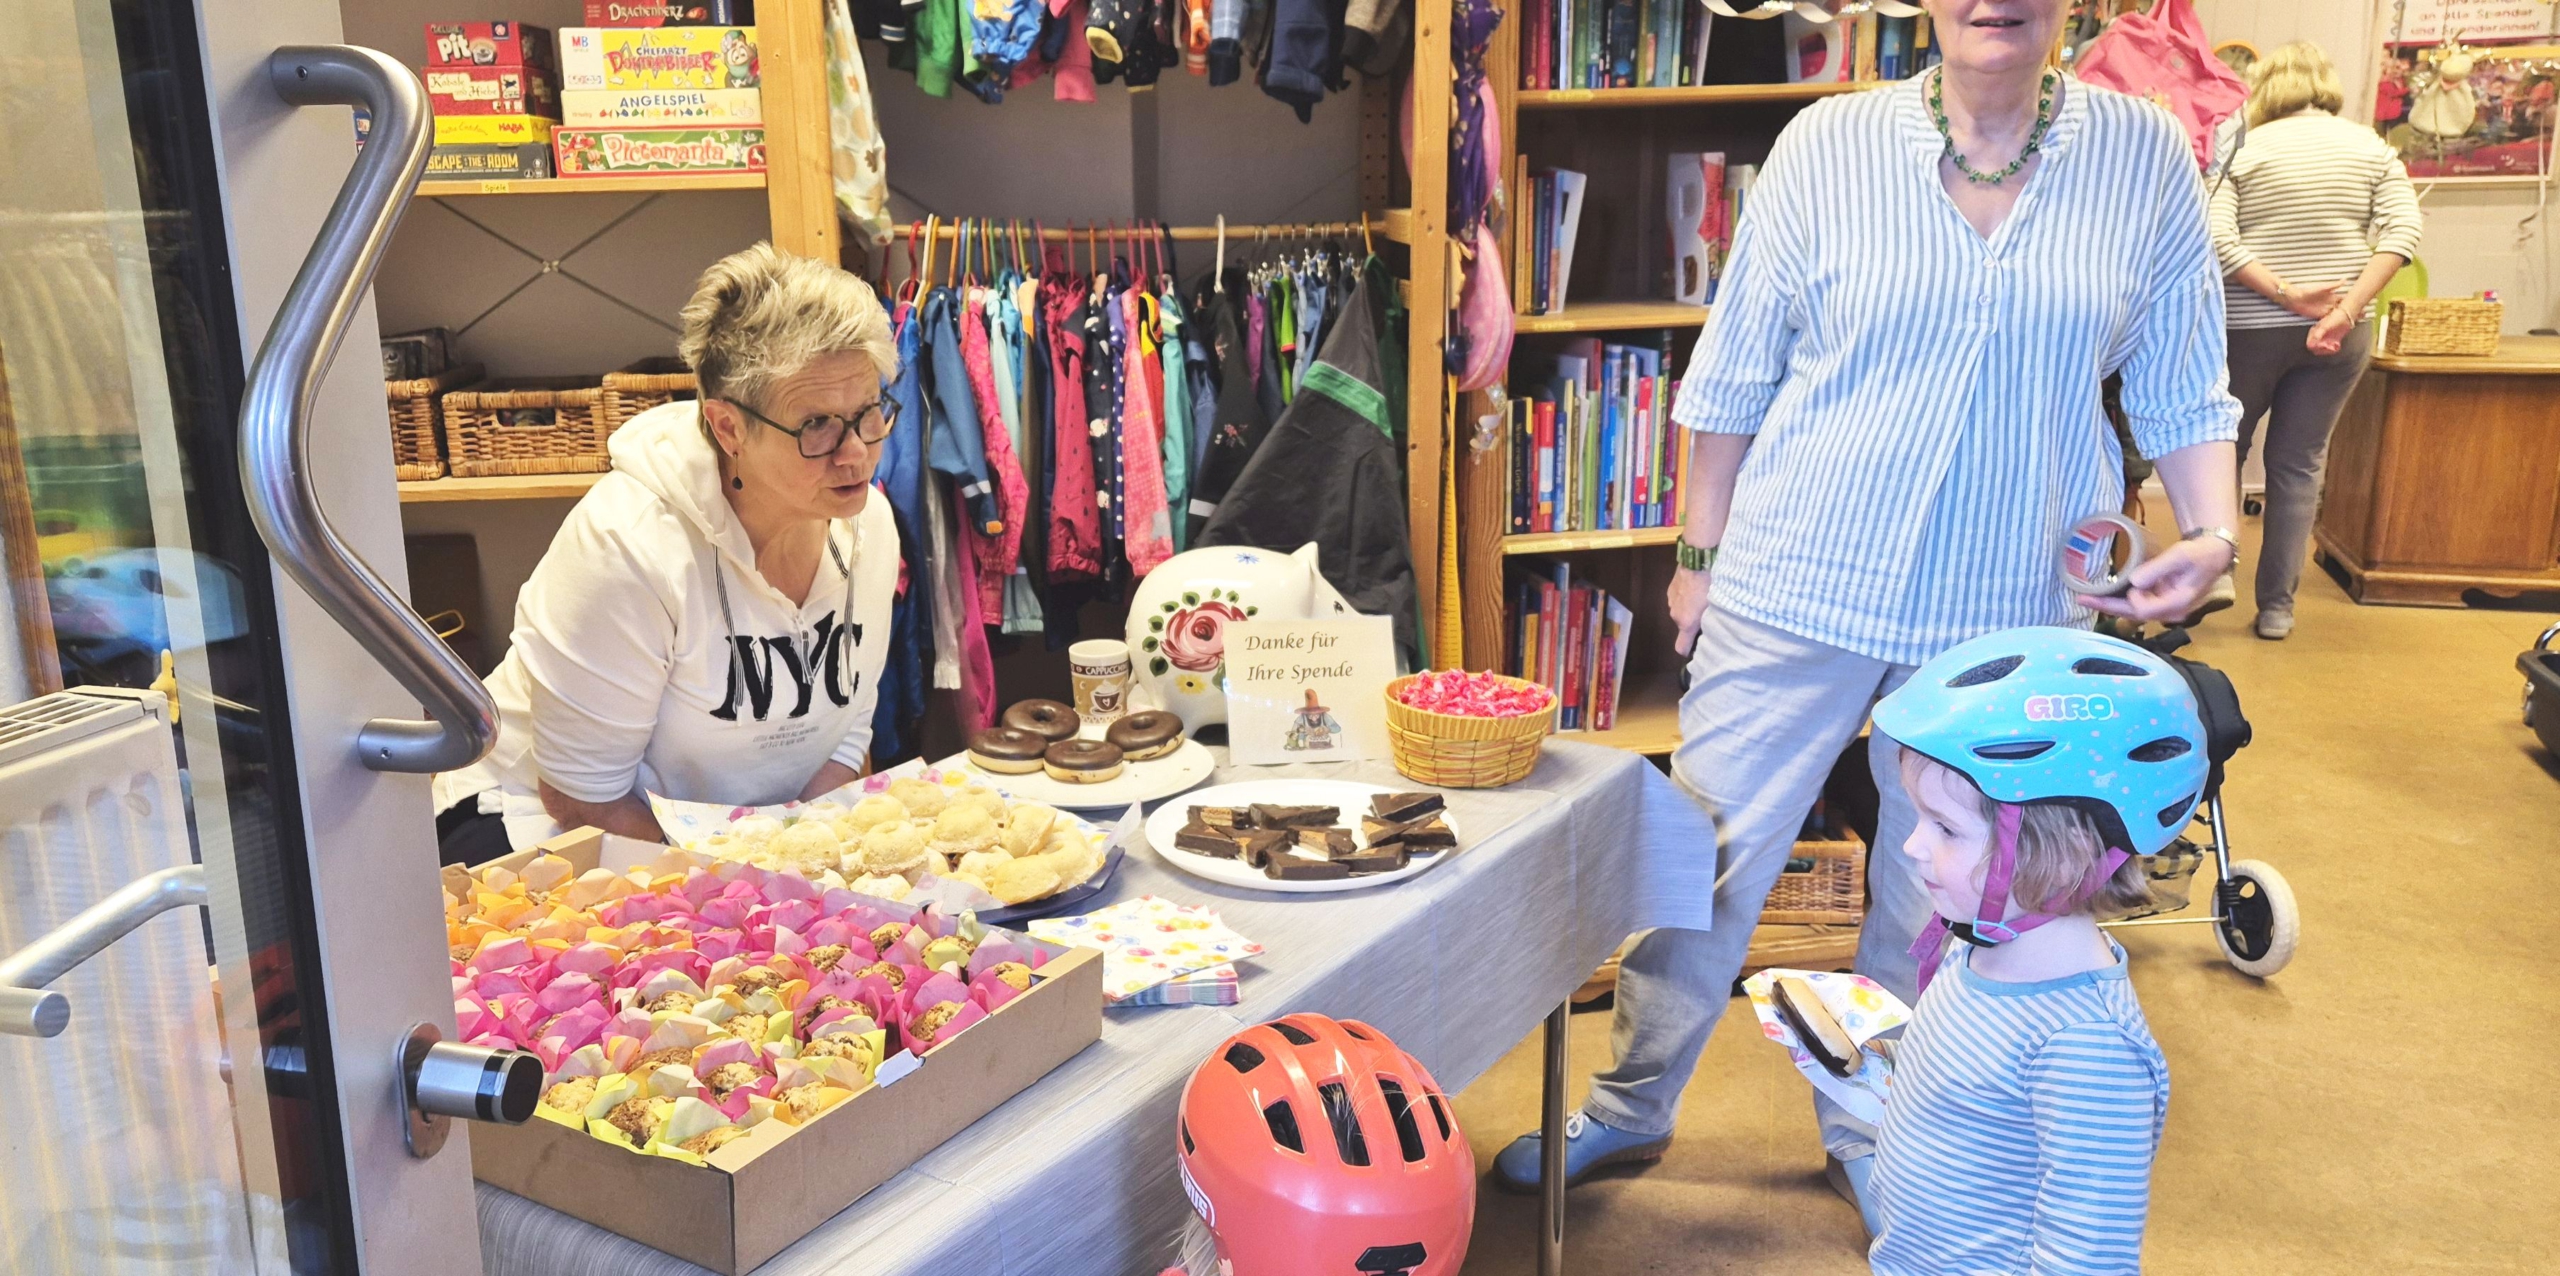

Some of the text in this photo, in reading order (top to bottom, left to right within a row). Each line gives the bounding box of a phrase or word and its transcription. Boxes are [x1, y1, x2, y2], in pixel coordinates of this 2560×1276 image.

[572, 36, 588, 48] MB
[636, 47, 687, 56] CHEFARZT
[620, 93, 707, 108] ANGELSPIEL
[498, 123, 525, 135] HABA
[604, 136, 725, 164] Pictomania
[428, 154, 463, 170] SCAPE
[487, 153, 519, 169] ROOM
[1245, 631, 1339, 654] Danke für
[709, 610, 863, 722] NYC
[1246, 662, 1354, 685] Ihre Spende
[2025, 694, 2113, 721] GIRO
